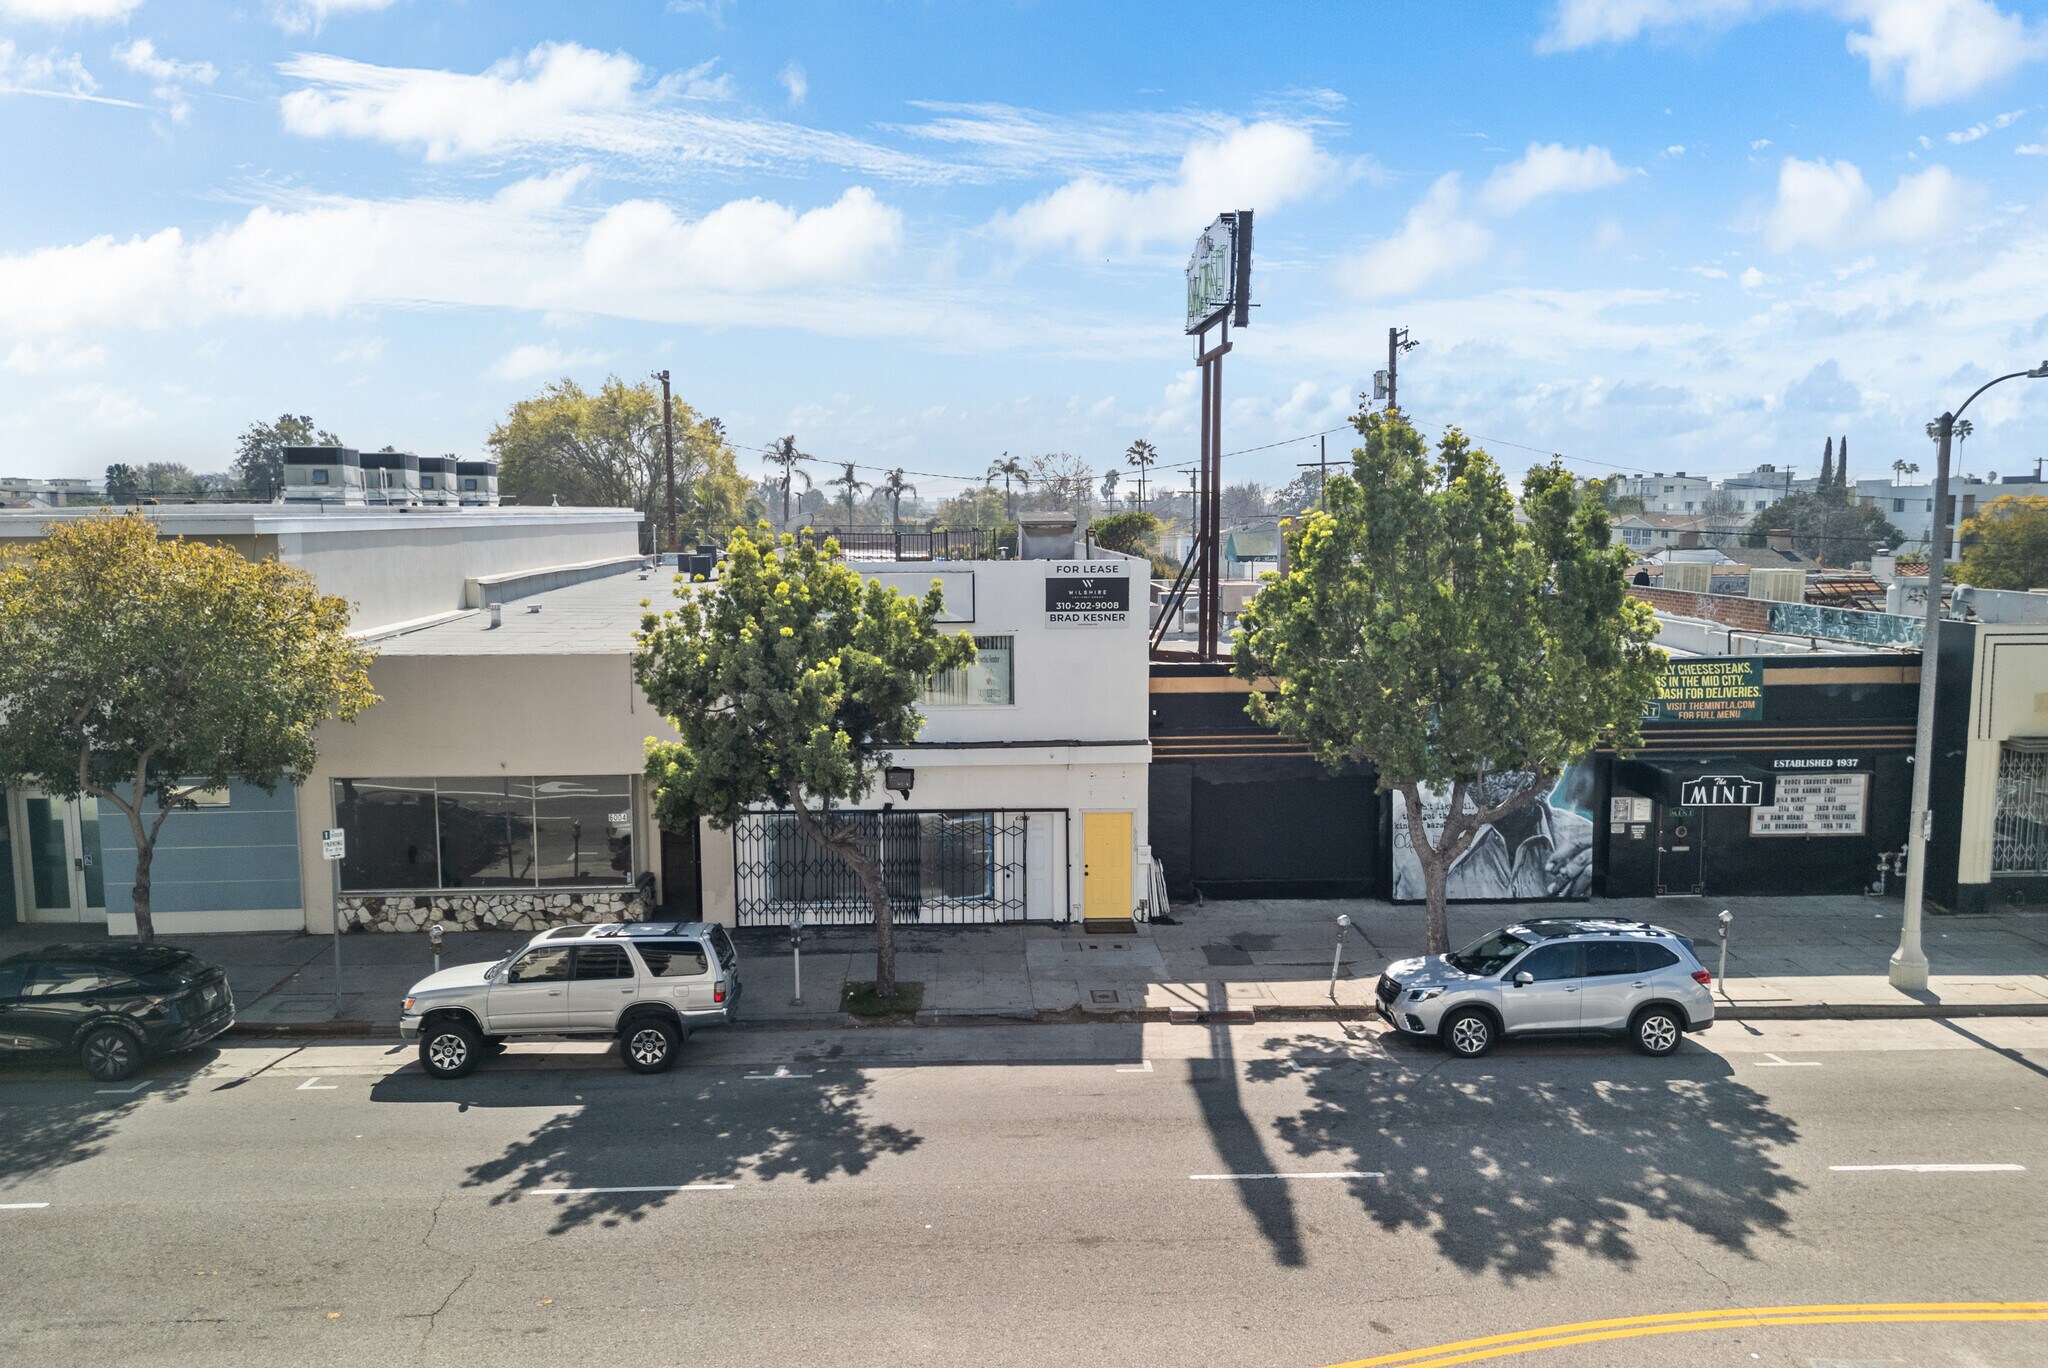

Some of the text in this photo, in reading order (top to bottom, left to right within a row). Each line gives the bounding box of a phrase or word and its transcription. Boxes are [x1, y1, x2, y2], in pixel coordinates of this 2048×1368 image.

[1056, 565, 1119, 574] FOR LEASE
[1056, 601, 1119, 610] 310-202-9008
[1050, 613, 1126, 622] BRAD KESNER
[1677, 662, 1753, 675] CHEESESTEAKS,
[1669, 676, 1679, 688] IN
[1681, 675, 1699, 687] THE
[1701, 674, 1719, 687] MID
[1722, 674, 1745, 686] CITY.
[1685, 687, 1704, 699] FOR
[1706, 686, 1761, 699] DELIVERIES.
[1666, 700, 1756, 711] VISIT THEMINTLA.COM
[1678, 710, 1741, 720] FOR FULL MENU
[1773, 758, 1859, 768] ESTABLISHED 1937
[1713, 777, 1727, 786] The
[1690, 785, 1752, 804] MINT
